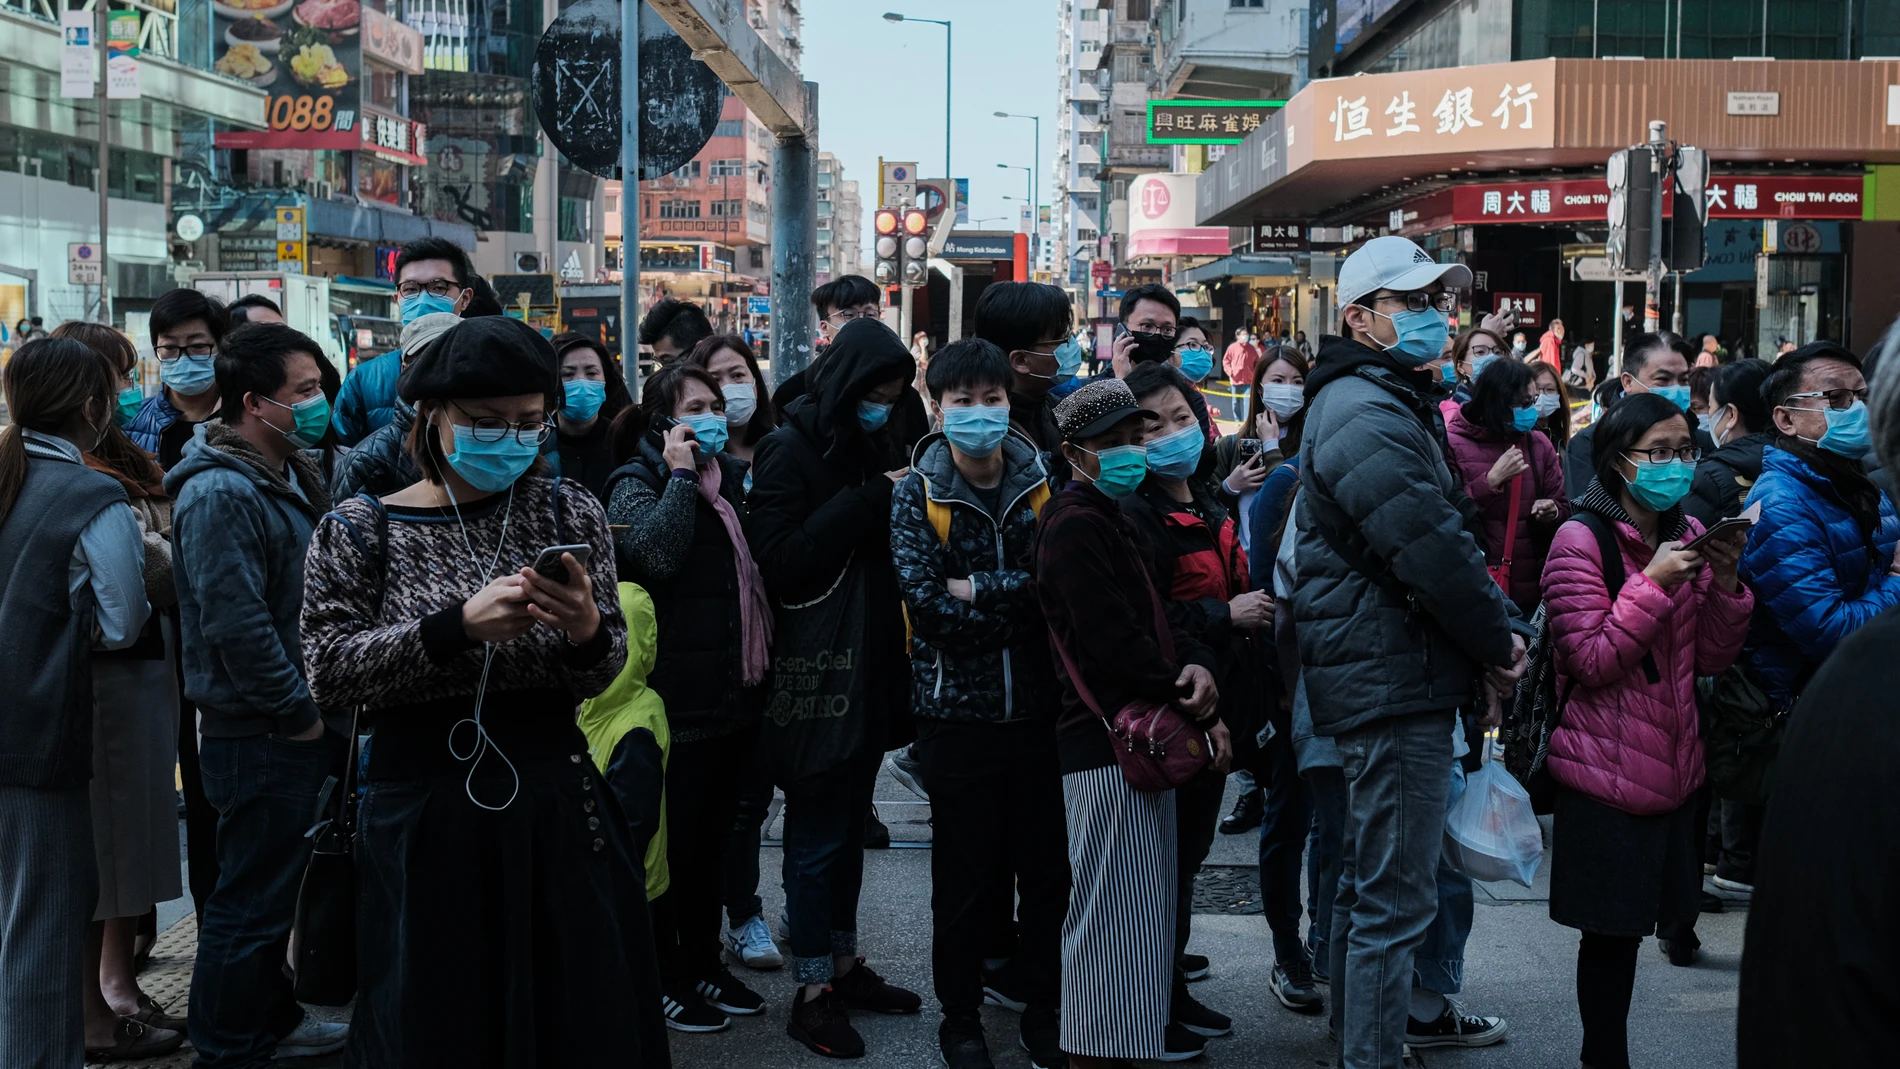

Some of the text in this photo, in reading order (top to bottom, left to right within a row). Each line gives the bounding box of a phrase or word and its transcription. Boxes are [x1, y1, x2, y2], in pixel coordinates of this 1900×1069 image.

[1329, 82, 1539, 142] 恒生銀行
[1155, 112, 1273, 133] 興旺麻雀娛
[1482, 189, 1608, 215] 周大福 CHOW TAI
[1774, 192, 1806, 203] CHOW
[1807, 192, 1825, 202] TAI
[1828, 192, 1859, 203] FOOK
[1261, 225, 1299, 238] 周大福
[956, 246, 974, 254] Mong
[986, 246, 1006, 254] Station
[75, 273, 95, 282] 全日
